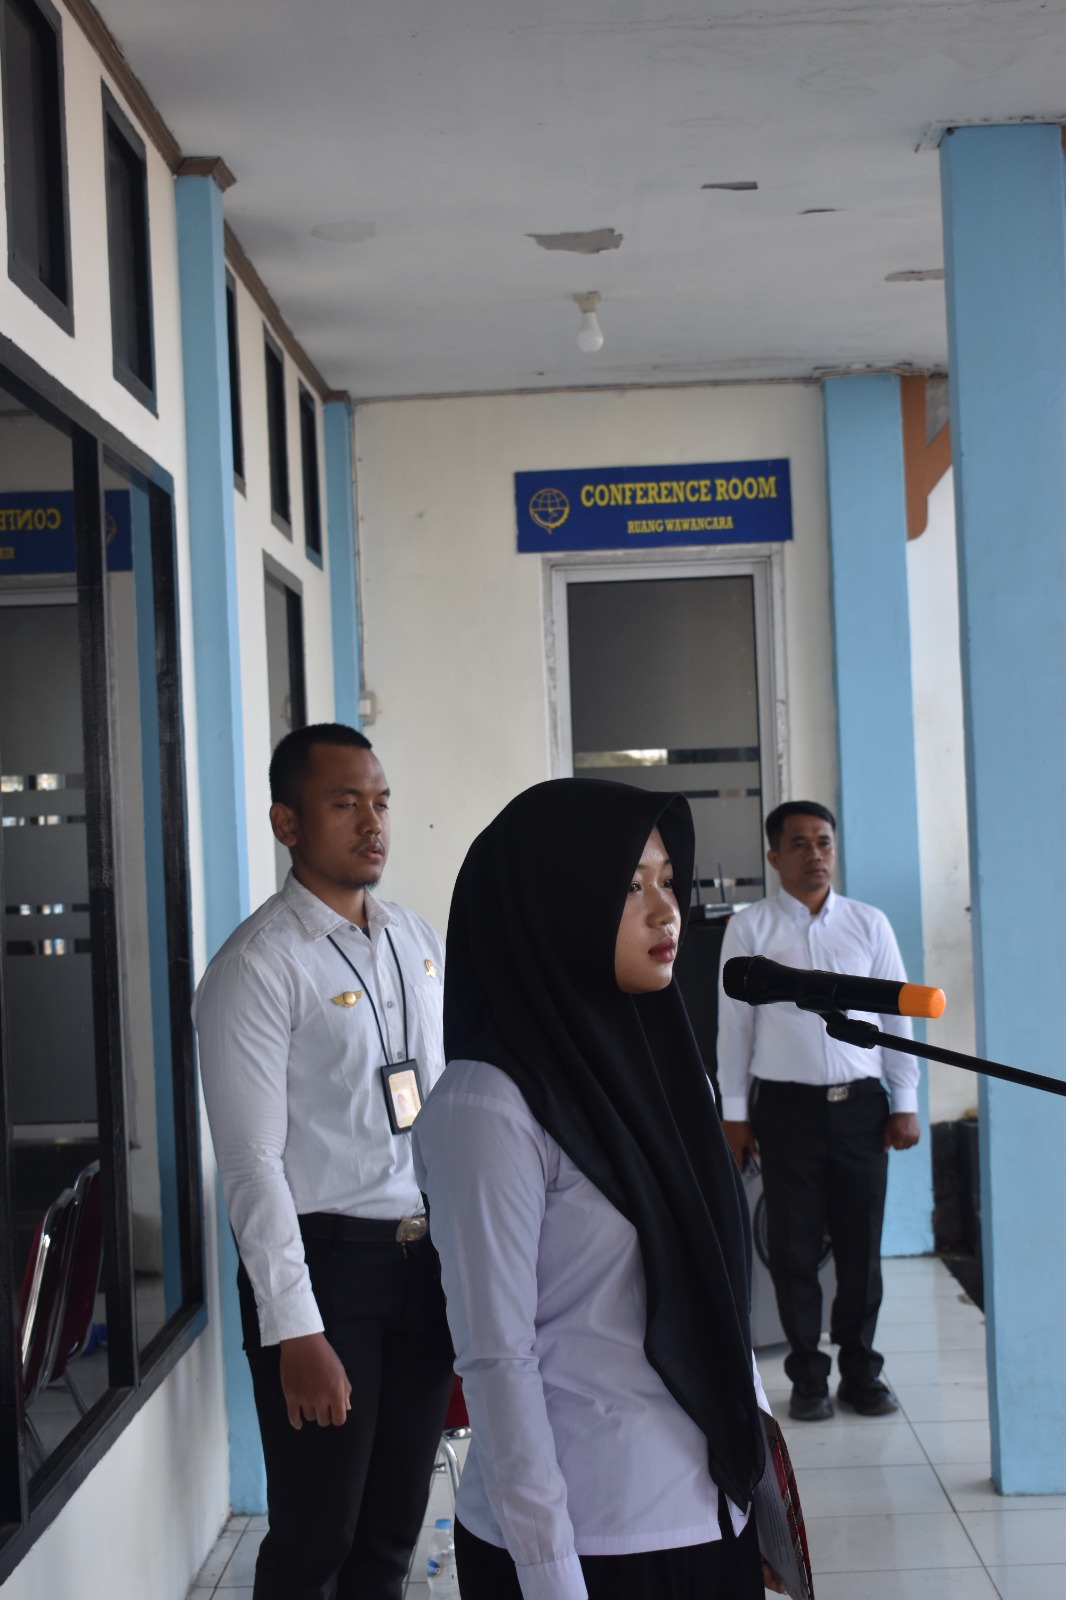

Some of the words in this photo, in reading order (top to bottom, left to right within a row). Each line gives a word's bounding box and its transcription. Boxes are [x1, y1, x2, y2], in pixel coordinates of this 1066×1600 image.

[580, 479, 711, 507] CONFERENCE
[715, 475, 778, 502] ROOM
[626, 519, 664, 534] RUANG
[664, 516, 734, 533] WAWANCARA
